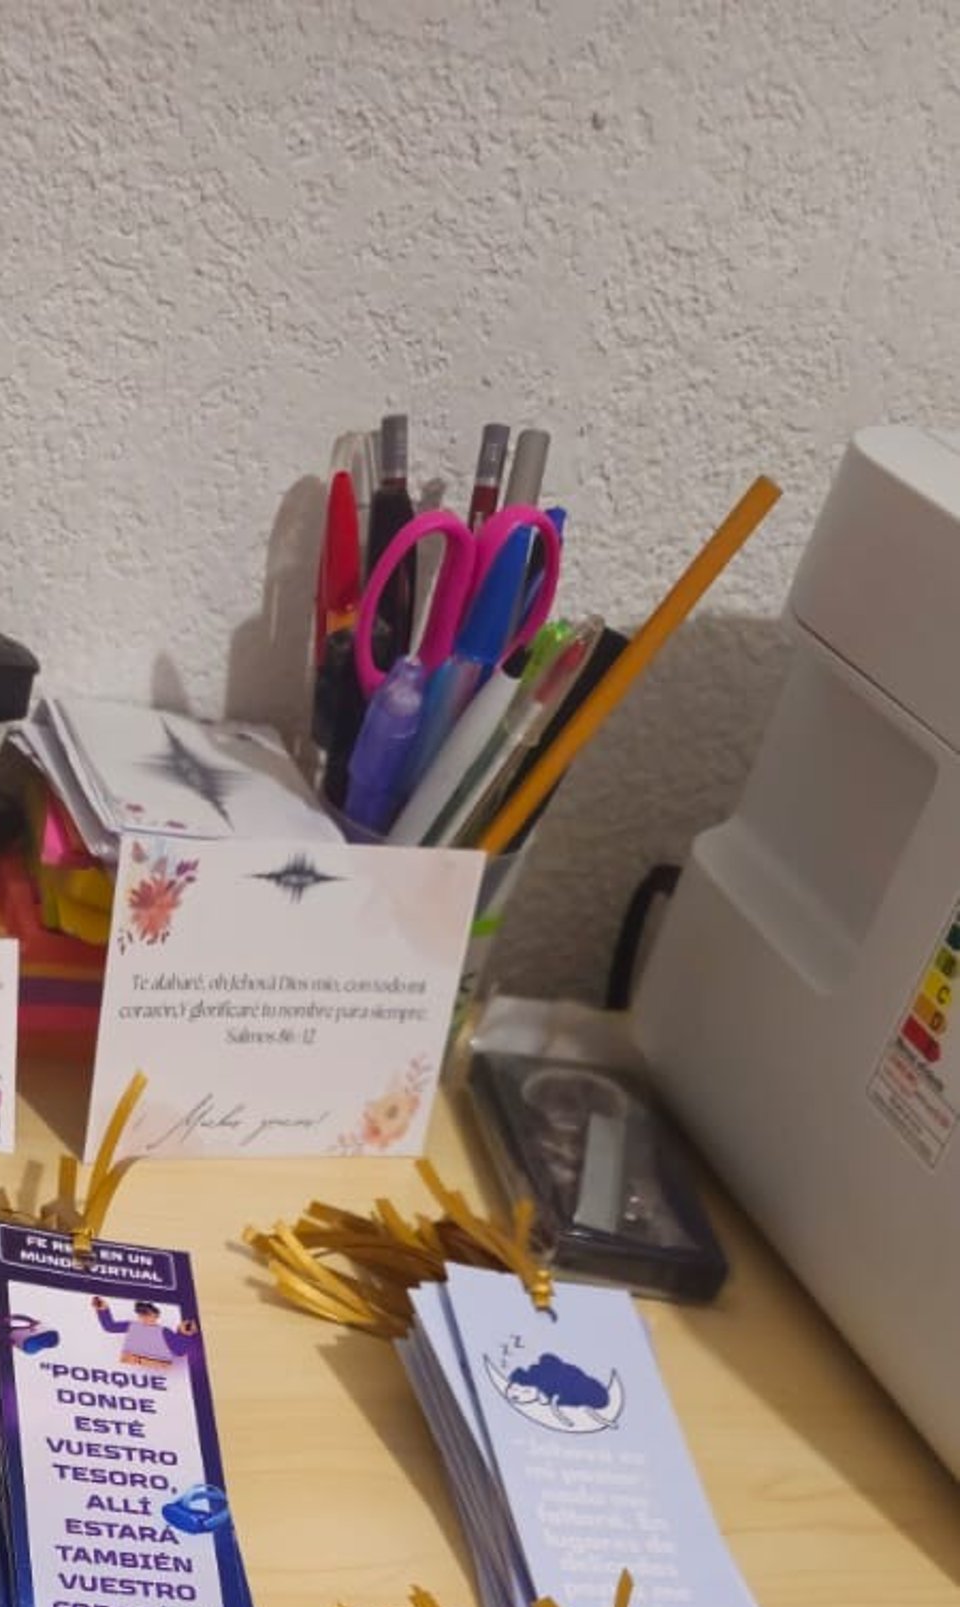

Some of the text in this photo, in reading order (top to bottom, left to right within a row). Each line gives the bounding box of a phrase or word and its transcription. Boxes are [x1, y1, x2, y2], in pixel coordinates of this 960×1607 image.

[26, 1235, 47, 1249] FE
[99, 1249, 123, 1262] EN
[128, 1253, 154, 1267] UN
[90, 1263, 163, 1283] VIRTUAL
[56, 1388, 158, 1414] DONDE
[74, 1415, 146, 1438] ESTÉ
[46, 1437, 179, 1467] VUESTRO
[86, 1494, 153, 1516] ALLÍ
[54, 1545, 194, 1573] TAMBIÉN
[57, 1572, 197, 1602] VUESTRO
